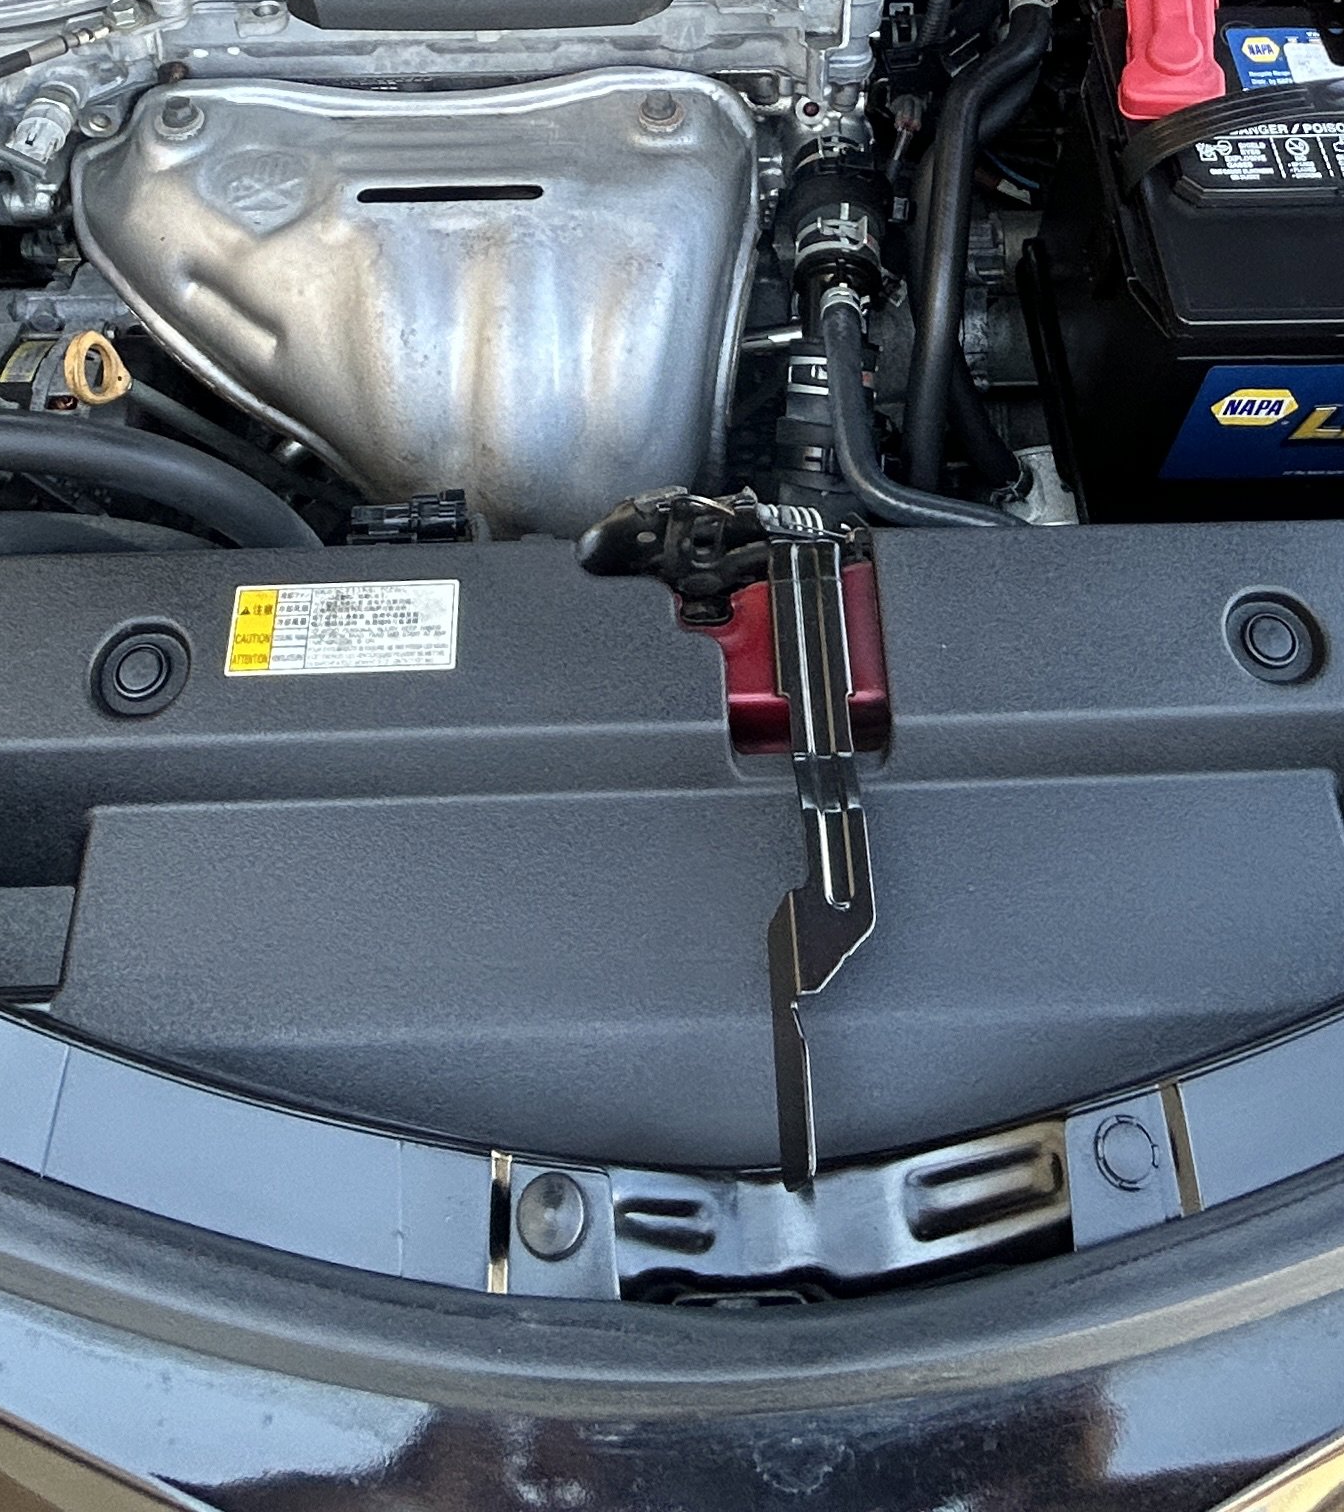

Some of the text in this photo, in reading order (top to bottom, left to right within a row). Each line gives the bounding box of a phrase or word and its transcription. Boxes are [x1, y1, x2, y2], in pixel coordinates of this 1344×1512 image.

[1247, 44, 1274, 55] NAPA
[1223, 399, 1283, 416] NAPA
[236, 633, 272, 645] CAUTION
